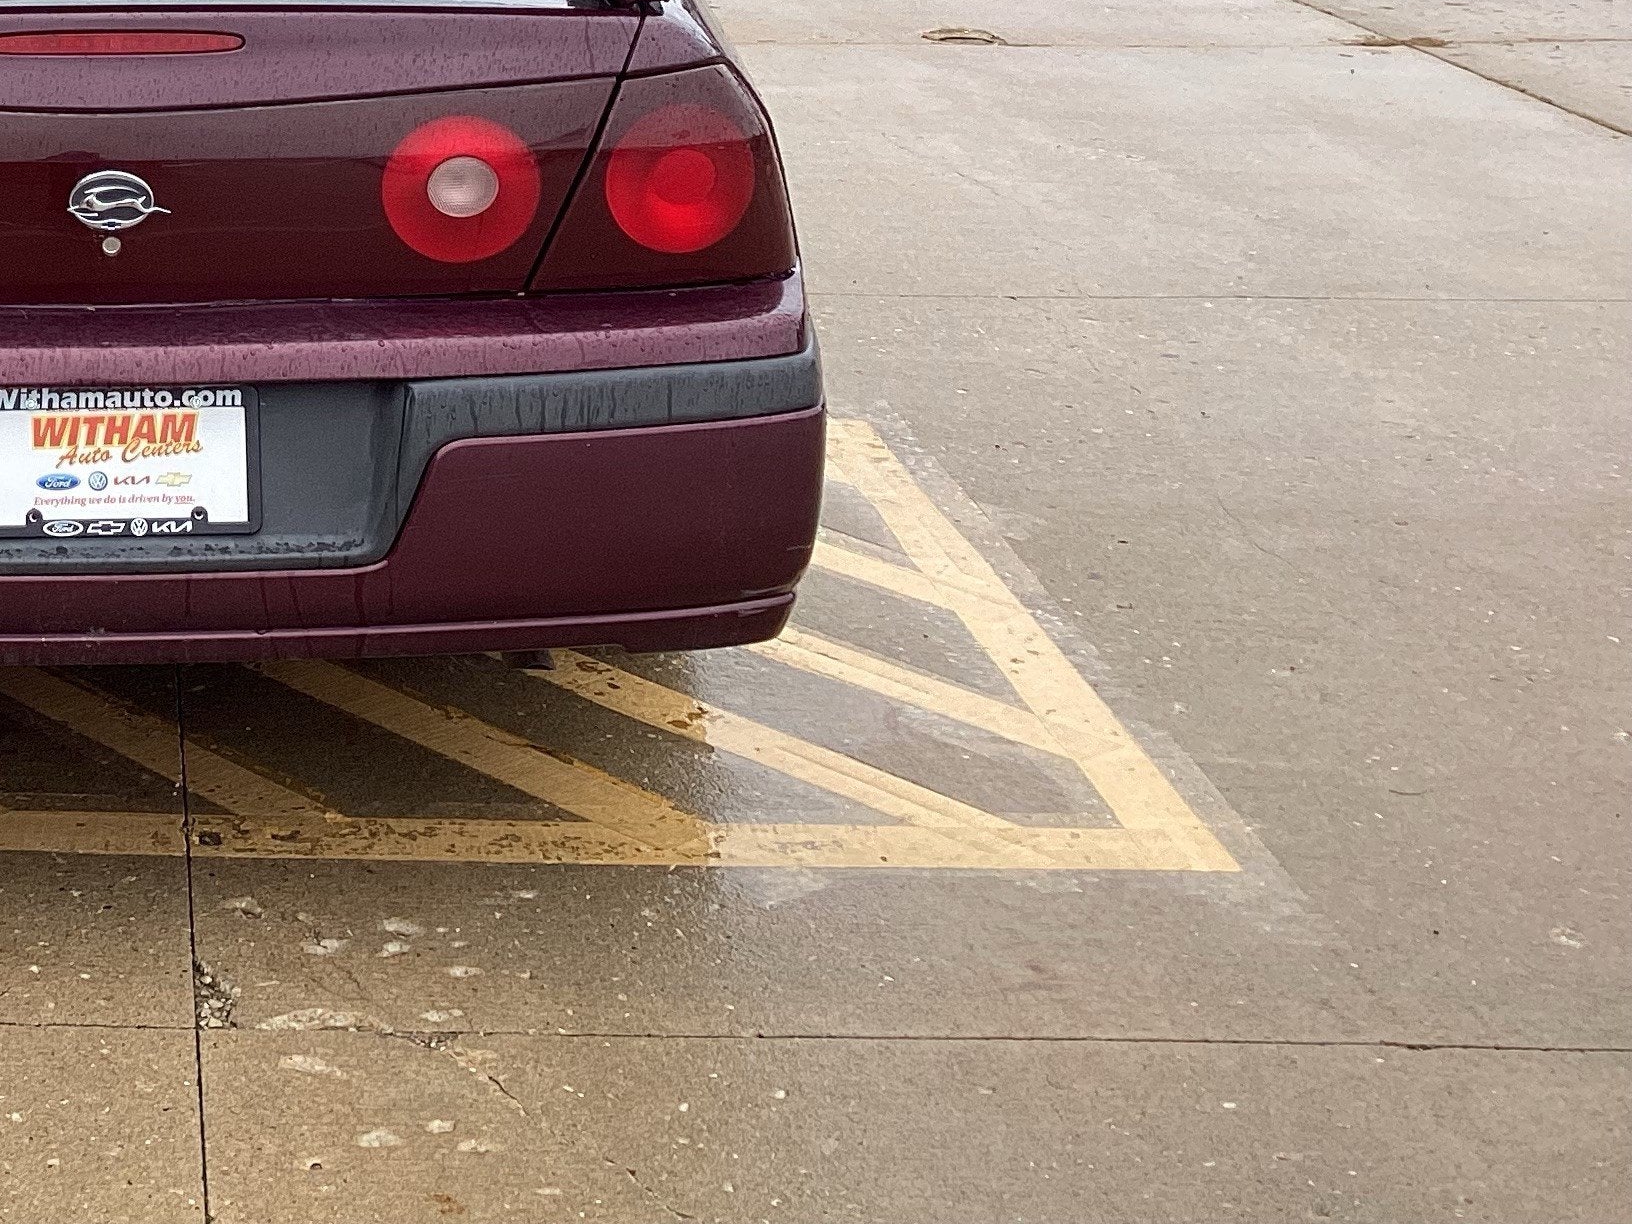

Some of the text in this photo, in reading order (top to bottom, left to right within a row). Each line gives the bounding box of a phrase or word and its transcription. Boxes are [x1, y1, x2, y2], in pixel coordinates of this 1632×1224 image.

[32, 412, 198, 448] WITHAM
[55, 439, 204, 469] Auto Centers
[43, 474, 74, 489] Ford
[34, 496, 87, 507] Everything
[88, 497, 102, 505] we
[104, 495, 116, 504] do
[118, 495, 127, 504] is
[128, 494, 160, 504] driven
[161, 494, 174, 506] by
